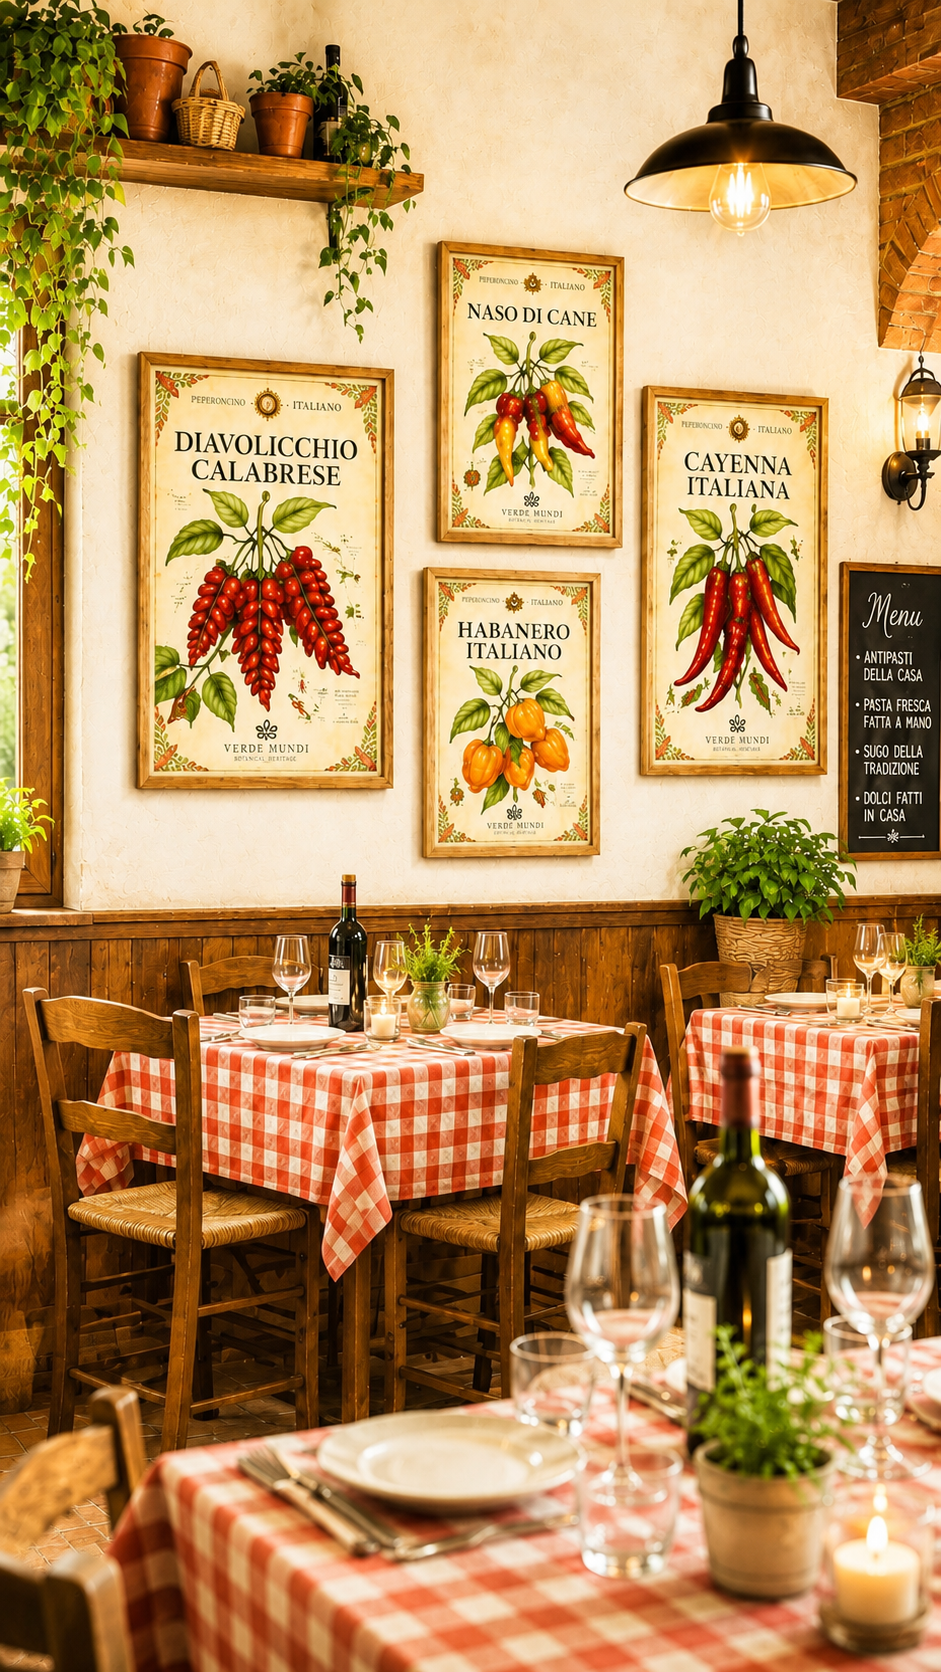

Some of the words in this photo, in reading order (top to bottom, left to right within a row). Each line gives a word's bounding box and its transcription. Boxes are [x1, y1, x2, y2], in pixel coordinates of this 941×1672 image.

[550, 281, 586, 291] ITALIANO
[467, 303, 518, 322] NASO
[523, 306, 543, 324] DI
[547, 309, 597, 327] CANE
[191, 395, 246, 406] PEPERONCINO
[293, 400, 342, 412] ITALIANO
[758, 425, 793, 435] ITALIANO
[174, 431, 358, 460] DIAVOLICCHIO
[684, 452, 792, 475] CAYENNA
[192, 459, 341, 486] CALABRESE
[687, 477, 790, 500] ITALIANA
[501, 508, 530, 517] VERDE
[534, 510, 563, 518] MUNDI
[862, 591, 923, 638] Menu
[458, 622, 570, 640] HABANERO
[467, 642, 562, 660] ITALIANO
[864, 650, 913, 665] ANTIPASTI
[864, 668, 893, 682] DELLA
[898, 669, 923, 682] CASA
[864, 698, 893, 712] PASTA
[896, 699, 931, 713] FRESCA
[864, 715, 891, 729] FATTA
[895, 716, 902, 729] A
[906, 716, 932, 729] MANO
[705, 736, 736, 745] VERDE
[739, 736, 770, 745] MUNDI
[224, 743, 264, 753] VERDE
[268, 743, 309, 753] MUNDI
[864, 745, 889, 759] SUGO
[894, 745, 923, 759] DELLA
[864, 762, 920, 776] TRADIZIONE
[864, 791, 891, 805] DOLCI
[896, 791, 923, 805] FATTI
[864, 808, 874, 822] IN
[879, 809, 906, 822] CASA
